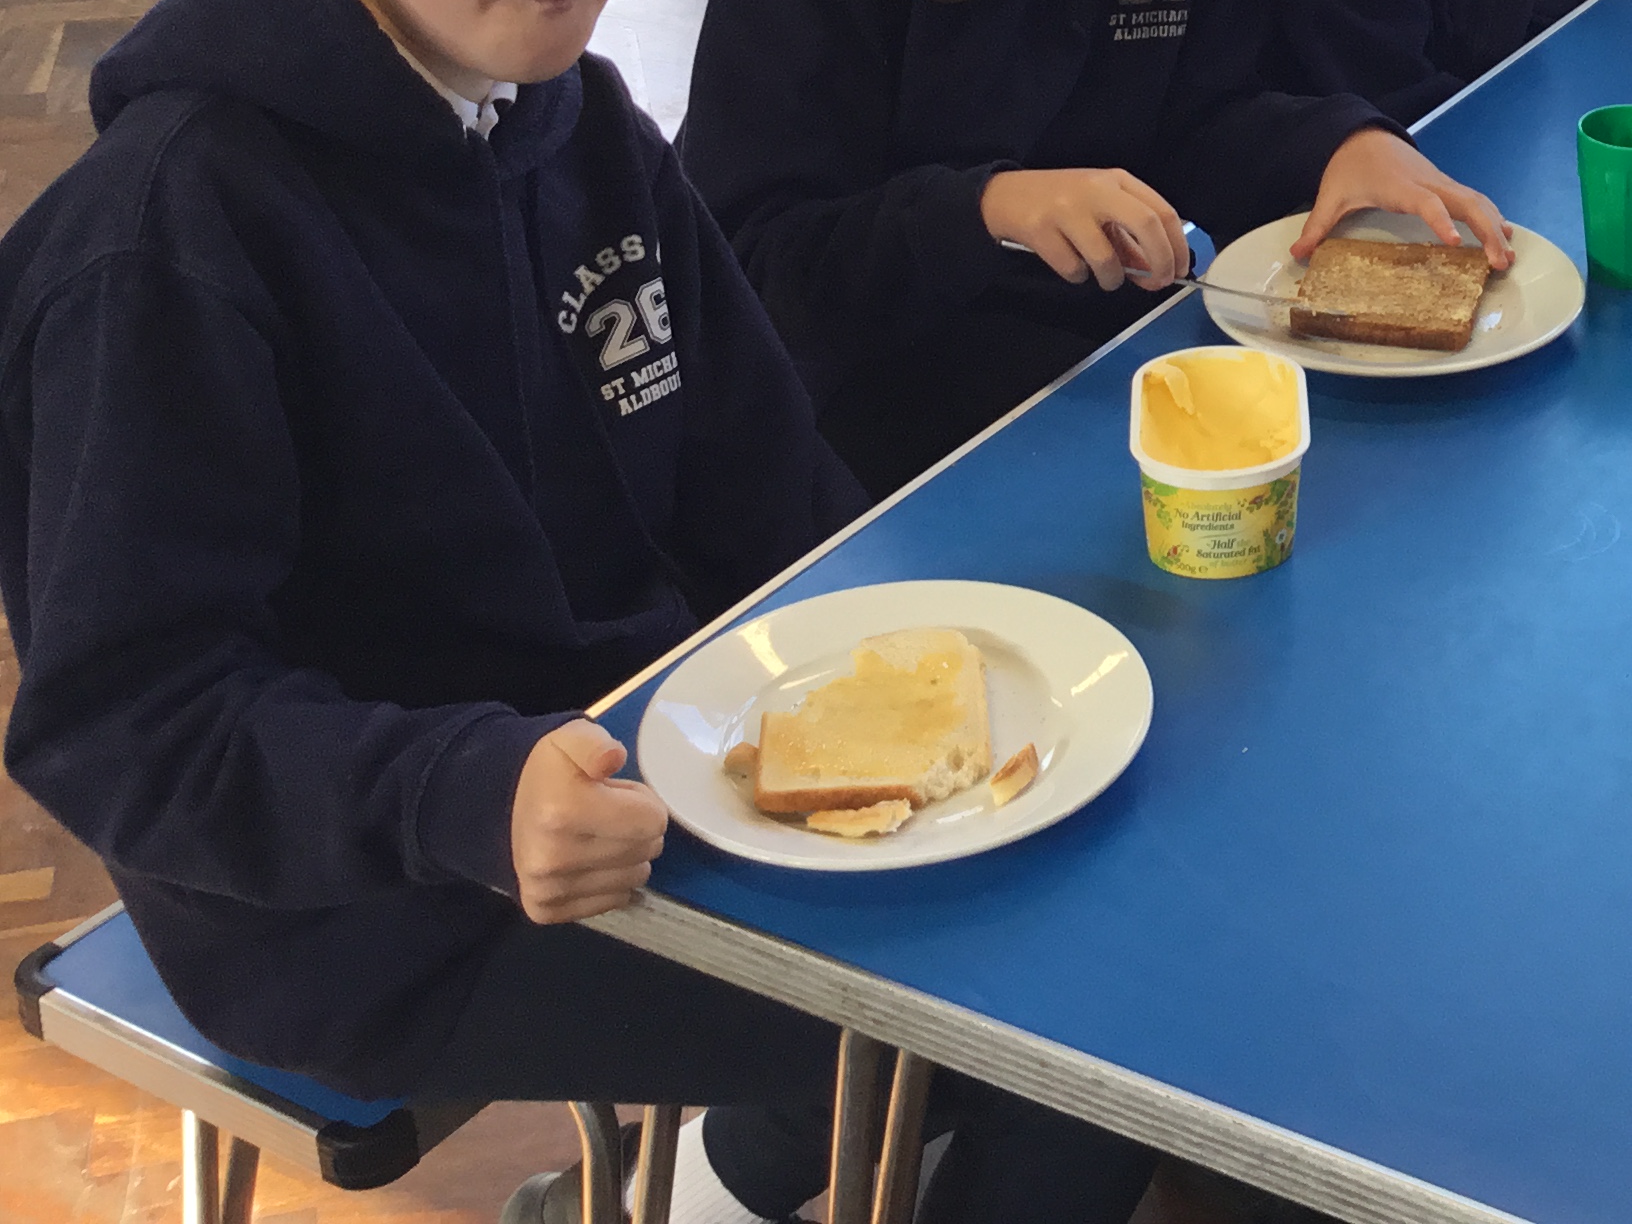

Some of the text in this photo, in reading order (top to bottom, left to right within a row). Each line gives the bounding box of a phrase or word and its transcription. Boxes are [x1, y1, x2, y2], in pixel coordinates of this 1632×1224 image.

[558, 233, 646, 335] CLASS
[600, 376, 626, 401] ST
[618, 370, 682, 417] ALDBOU
[1174, 508, 1242, 522] No Artificial
[1181, 520, 1235, 531] Ingredients
[1209, 538, 1236, 549] Half
[1196, 548, 1246, 559] Saturated
